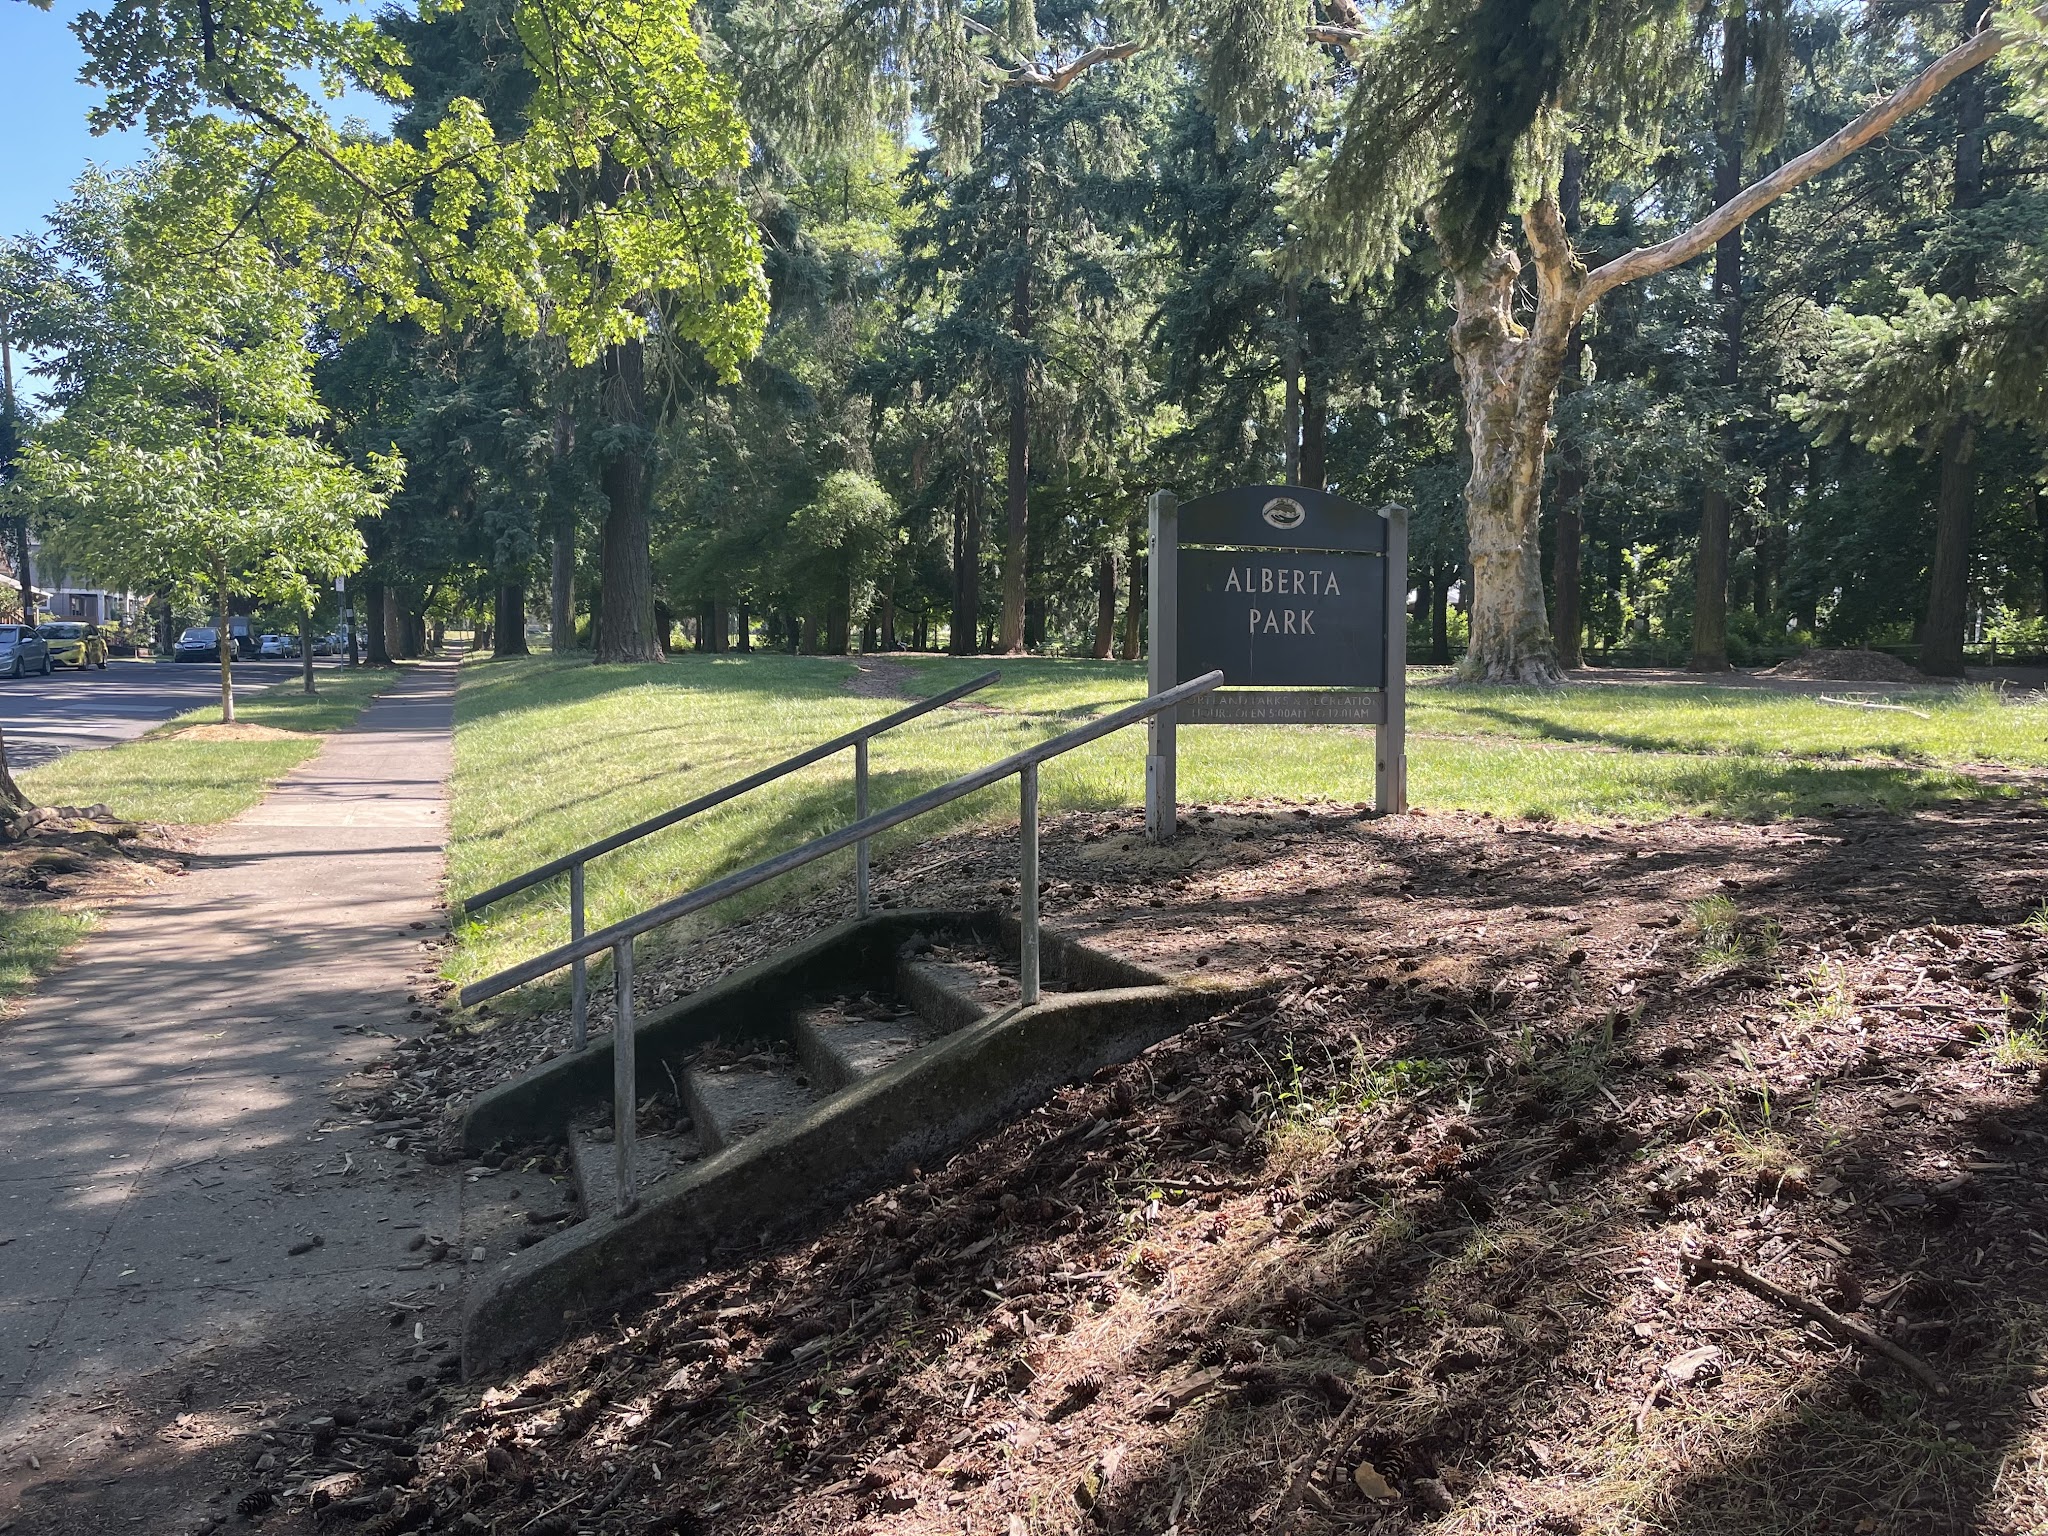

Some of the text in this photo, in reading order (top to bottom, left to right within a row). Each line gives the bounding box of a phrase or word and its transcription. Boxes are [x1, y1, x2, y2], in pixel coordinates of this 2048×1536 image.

[1225, 567, 1341, 596] ALBERTA
[1249, 609, 1316, 635] PARK
[1184, 695, 1248, 705] ORTLAND
